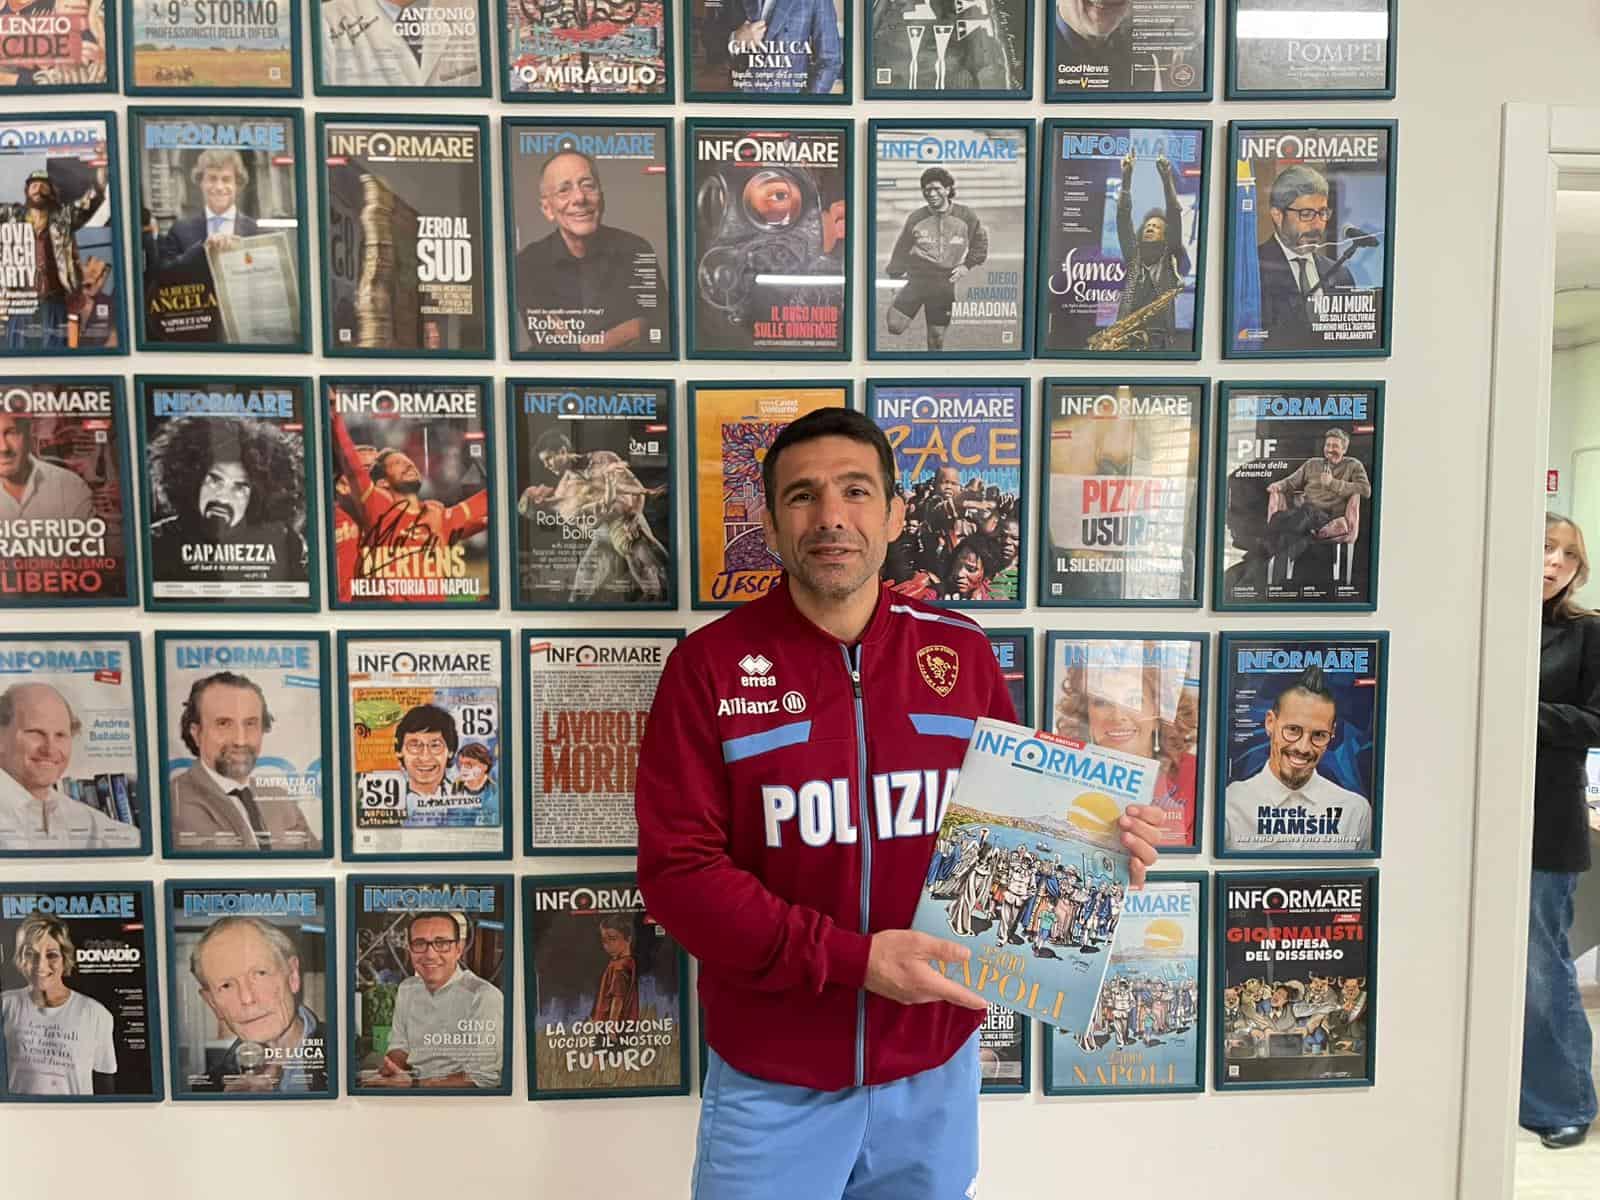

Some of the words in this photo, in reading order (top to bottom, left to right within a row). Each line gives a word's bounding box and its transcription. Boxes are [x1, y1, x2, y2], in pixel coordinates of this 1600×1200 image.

[195, 0, 279, 25] STORMO
[399, 7, 474, 22] ANTONIO
[392, 22, 475, 37] GIORDANO
[728, 40, 813, 55] GIANLUCA
[748, 54, 793, 68] ISAIA
[1058, 64, 1082, 74] Good
[1083, 64, 1109, 74] News
[144, 123, 287, 152] INFORMARE
[331, 132, 474, 158] INFORMARE
[519, 131, 655, 156] INFORMARE
[1241, 135, 1378, 159] INFORMARE
[698, 138, 839, 163] INFORMARE
[882, 137, 1018, 160] INFORMARE
[1062, 134, 1195, 163] INFORMARE
[416, 216, 452, 239] ZERO
[453, 217, 471, 239] AL
[416, 239, 473, 283] SUD
[1048, 247, 1127, 295] James
[987, 271, 1018, 286] DIEGO
[967, 286, 1018, 301] ARMANDO
[1072, 281, 1121, 303] Senese
[150, 294, 217, 315] ANGELA
[951, 301, 1018, 318] MARADONA
[528, 315, 585, 330] Roberto
[535, 330, 605, 345] Vecchioni
[153, 391, 294, 417] INFORMARE
[335, 390, 477, 413] INFORMARE
[524, 392, 657, 415] INFORMARE
[877, 396, 1014, 419] INFORMARE
[1060, 395, 1192, 417] INFORMARE
[1235, 397, 1368, 420] INFORMARE
[1238, 439, 1278, 458] PIF
[536, 510, 598, 526] Roberto
[181, 544, 277, 563] CAPAREZZA
[362, 545, 466, 579] MERTENS
[1056, 558, 1069, 573] IL
[1070, 558, 1124, 573] SILENZIO
[1, 571, 103, 593] LIBERO
[351, 578, 386, 597] NELLA
[387, 578, 426, 597] STORIA
[427, 578, 439, 597] DI
[440, 579, 480, 597] NAPOLI
[176, 645, 311, 669] INFORMARE
[357, 652, 491, 673] INFORMARE
[546, 645, 661, 663] INFORMARE
[1237, 650, 1369, 673] INFORMARE
[740, 675, 776, 687] errea
[717, 698, 779, 716] Allianz
[543, 710, 631, 744] LAVORO
[974, 729, 1144, 795] INFORMARE
[1257, 805, 1307, 818] Marek
[1326, 807, 1343, 818] 17
[3, 895, 135, 918] INFORMARE
[184, 892, 317, 917] INFORMARE
[364, 888, 496, 912] INFORMARE
[1228, 887, 1362, 910] INFORMARE
[1227, 925, 1363, 943] GIORNALISTI
[1260, 939, 1276, 949] IN
[1281, 938, 1329, 949] DIFESA
[76, 945, 141, 962] DONADIO
[1245, 951, 1271, 962] DEL
[1275, 949, 1344, 961] DISSENSO
[457, 1019, 497, 1032] GINO
[546, 1022, 566, 1036] LA
[572, 1017, 673, 1036] CORRUZIONE
[423, 1033, 497, 1046] SORBILLO
[548, 1036, 596, 1049] UCCIDE
[602, 1037, 614, 1047] IL
[619, 1034, 671, 1047] NOSTRO
[264, 1048, 283, 1059] DE
[286, 1047, 324, 1059] LUCA
[566, 1048, 657, 1072] FUTURO
